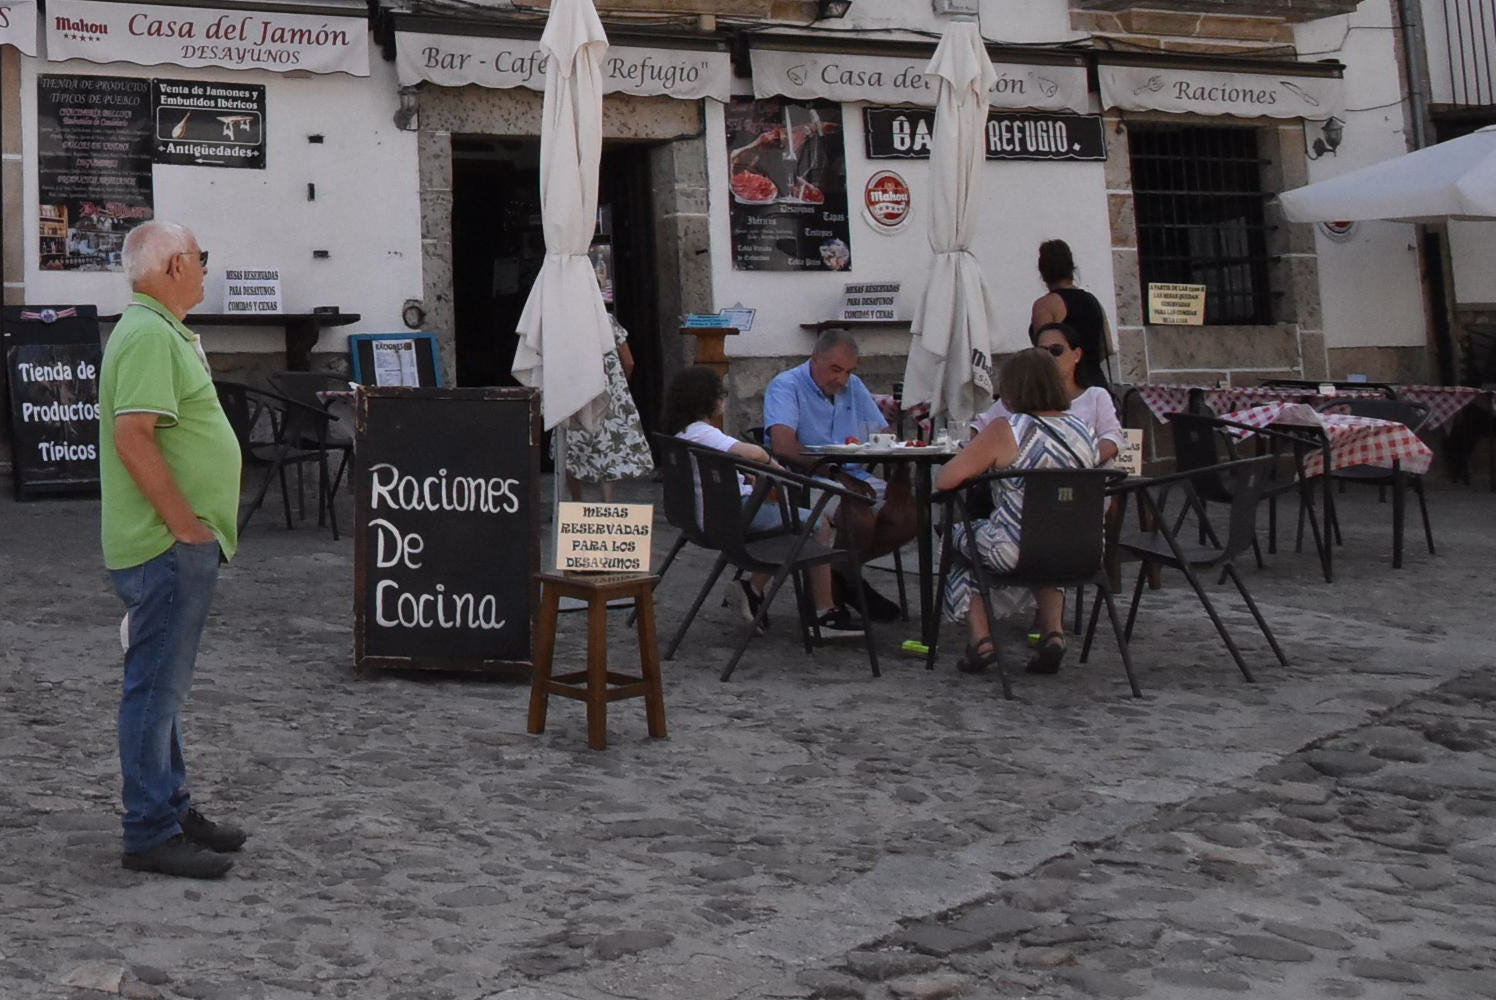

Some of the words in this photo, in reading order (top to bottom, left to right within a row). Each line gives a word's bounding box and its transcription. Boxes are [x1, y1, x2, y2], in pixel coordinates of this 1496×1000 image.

[55, 16, 109, 35] Mahou
[128, 13, 195, 39] Casa
[205, 15, 253, 42] del
[253, 21, 350, 47] Jamón
[181, 44, 301, 65] DESAYUNOS
[422, 47, 472, 70] Bar
[820, 64, 882, 87] Casa
[42, 78, 78, 89] TIENDA
[80, 79, 94, 89] DE
[95, 80, 149, 92] PRODUCTOS
[159, 83, 190, 94] Venta
[191, 85, 204, 95] de
[206, 86, 250, 98] Jamones
[251, 91, 259, 100] y
[103, 94, 141, 105] PUEBLO
[1173, 81, 1277, 105] Raciones
[160, 95, 215, 107] Embutidos
[218, 98, 258, 110] Ibéricos
[166, 143, 253, 158] Antigüedades
[870, 191, 908, 202] Mahou
[226, 270, 243, 281] MESAS
[244, 270, 279, 281] RESERVADAS
[229, 286, 242, 296] PARA
[243, 286, 276, 296] DESAYUNOS
[845, 285, 864, 294] MESAS
[865, 284, 901, 294] RESERVADAS
[228, 301, 252, 312] COMIDAS
[258, 301, 278, 311] CENAS
[18, 361, 73, 383] Tienda
[77, 360, 96, 380] de
[22, 401, 101, 423] Productos
[38, 440, 97, 462] Típicos
[368, 463, 520, 513] Raciones
[583, 506, 629, 519] MESAS
[560, 522, 649, 536] RESERVADAS
[368, 518, 425, 570] De
[572, 540, 609, 552] PARA
[612, 540, 636, 553] LOS
[566, 557, 641, 570] DESAYUNOS
[375, 579, 506, 630] Cocina
